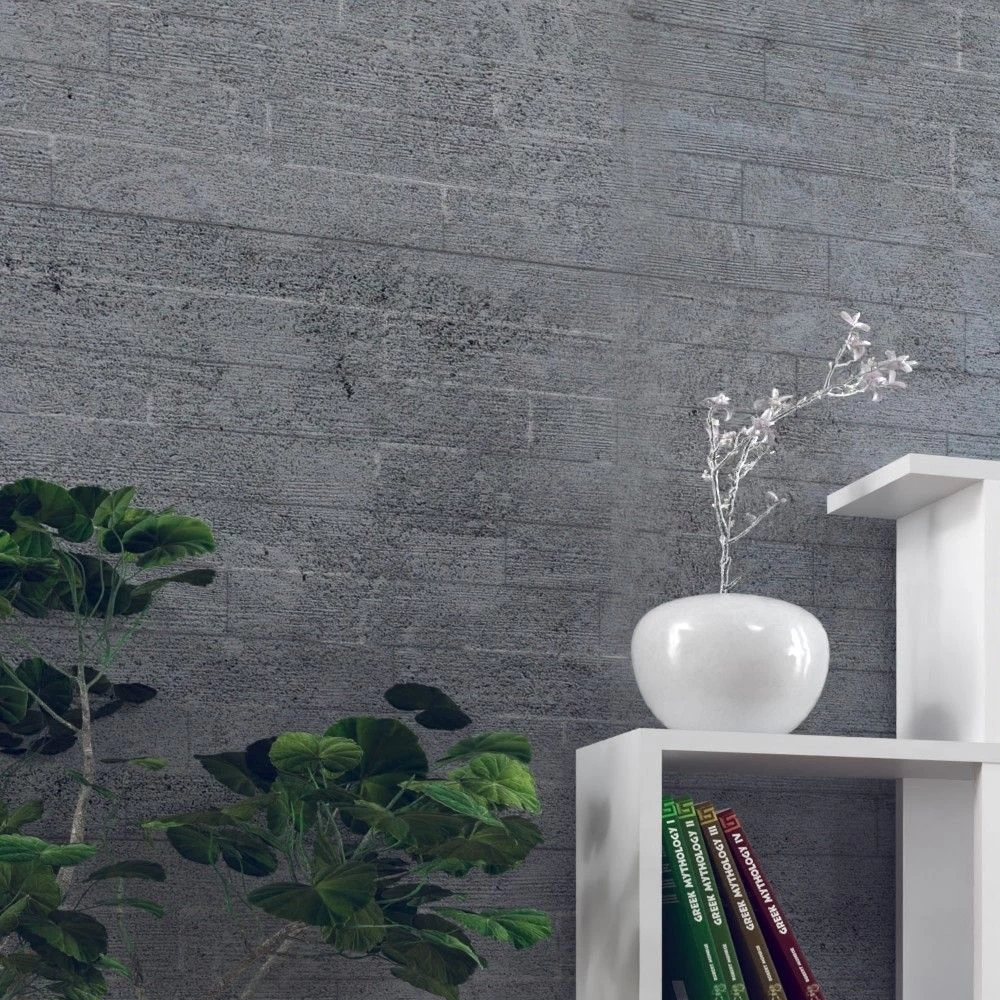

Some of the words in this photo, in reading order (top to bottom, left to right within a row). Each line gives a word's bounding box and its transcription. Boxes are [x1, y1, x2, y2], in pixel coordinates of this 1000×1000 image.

[685, 820, 695, 828] II
[707, 825, 719, 836] III
[731, 832, 744, 844] IV
[668, 827, 694, 888] MYTHOLOGY
[687, 830, 714, 892] MYTHOLOGY
[712, 838, 743, 898] MYTHOLOGY
[738, 845, 773, 904] MYTHOLOGY
[687, 891, 703, 923] GREEK
[706, 893, 723, 926] GREEK
[736, 899, 755, 931] GREEK
[767, 904, 788, 935] GREEK
